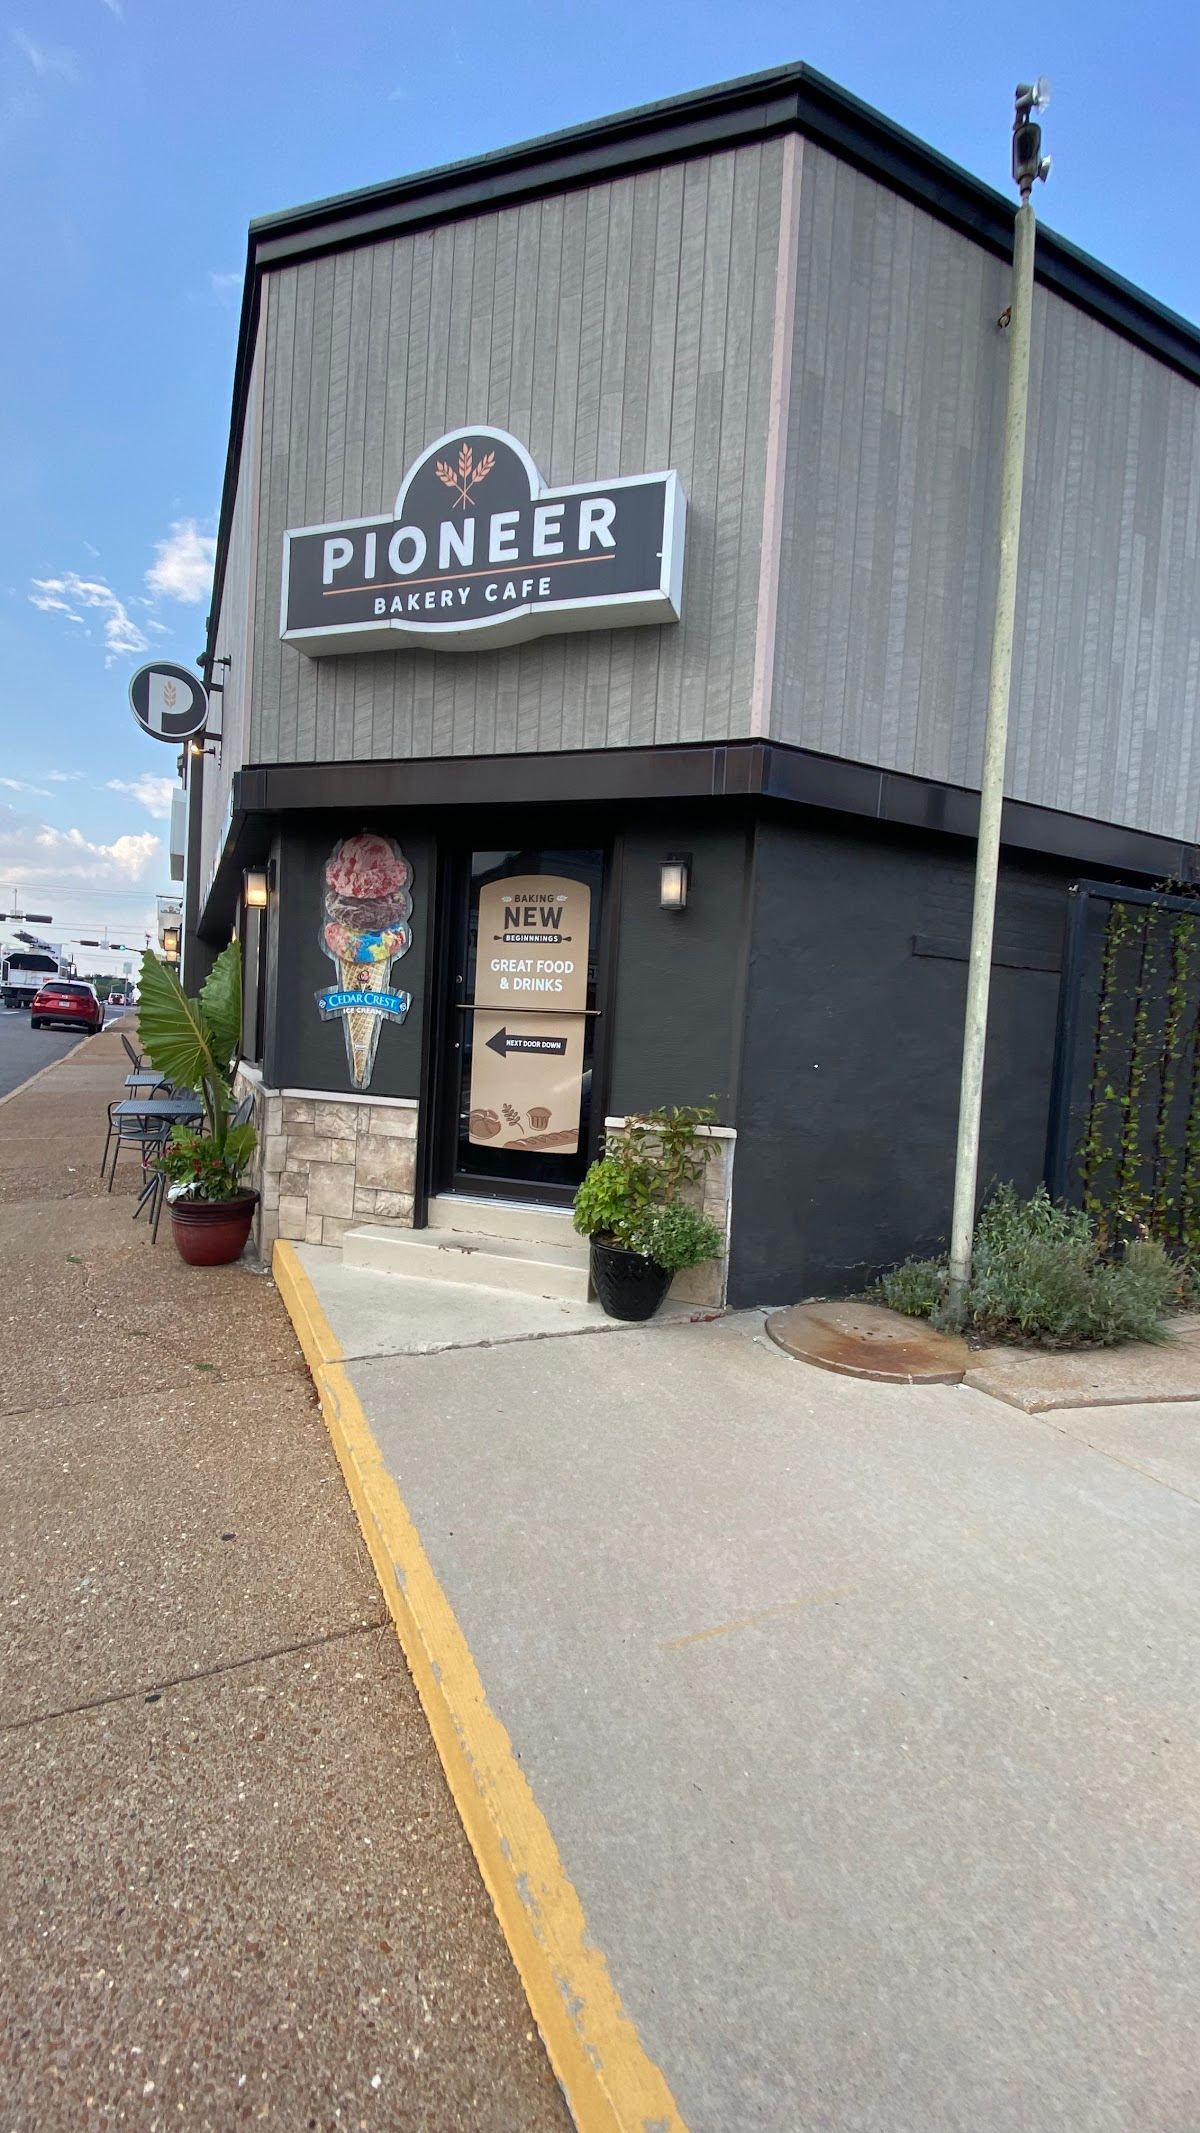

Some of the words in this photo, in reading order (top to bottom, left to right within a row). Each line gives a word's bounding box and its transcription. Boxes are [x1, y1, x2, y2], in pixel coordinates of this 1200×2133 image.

[323, 497, 617, 585] PIONEER
[373, 586, 472, 615] BAKERY
[484, 576, 552, 602] CAFE
[514, 894, 555, 903] BAKING
[504, 906, 563, 930] NEW
[490, 958, 534, 973] GREAT
[536, 960, 574, 974] FOOD
[499, 977, 509, 990] &
[513, 978, 563, 992] DRINKS
[328, 994, 363, 1007] CEDAR
[363, 993, 398, 1009] CREST
[356, 1007, 383, 1015] CREAM
[506, 1039, 522, 1047] NEXT
[523, 1040, 541, 1048] DOOR
[542, 1041, 561, 1049] DOWN
